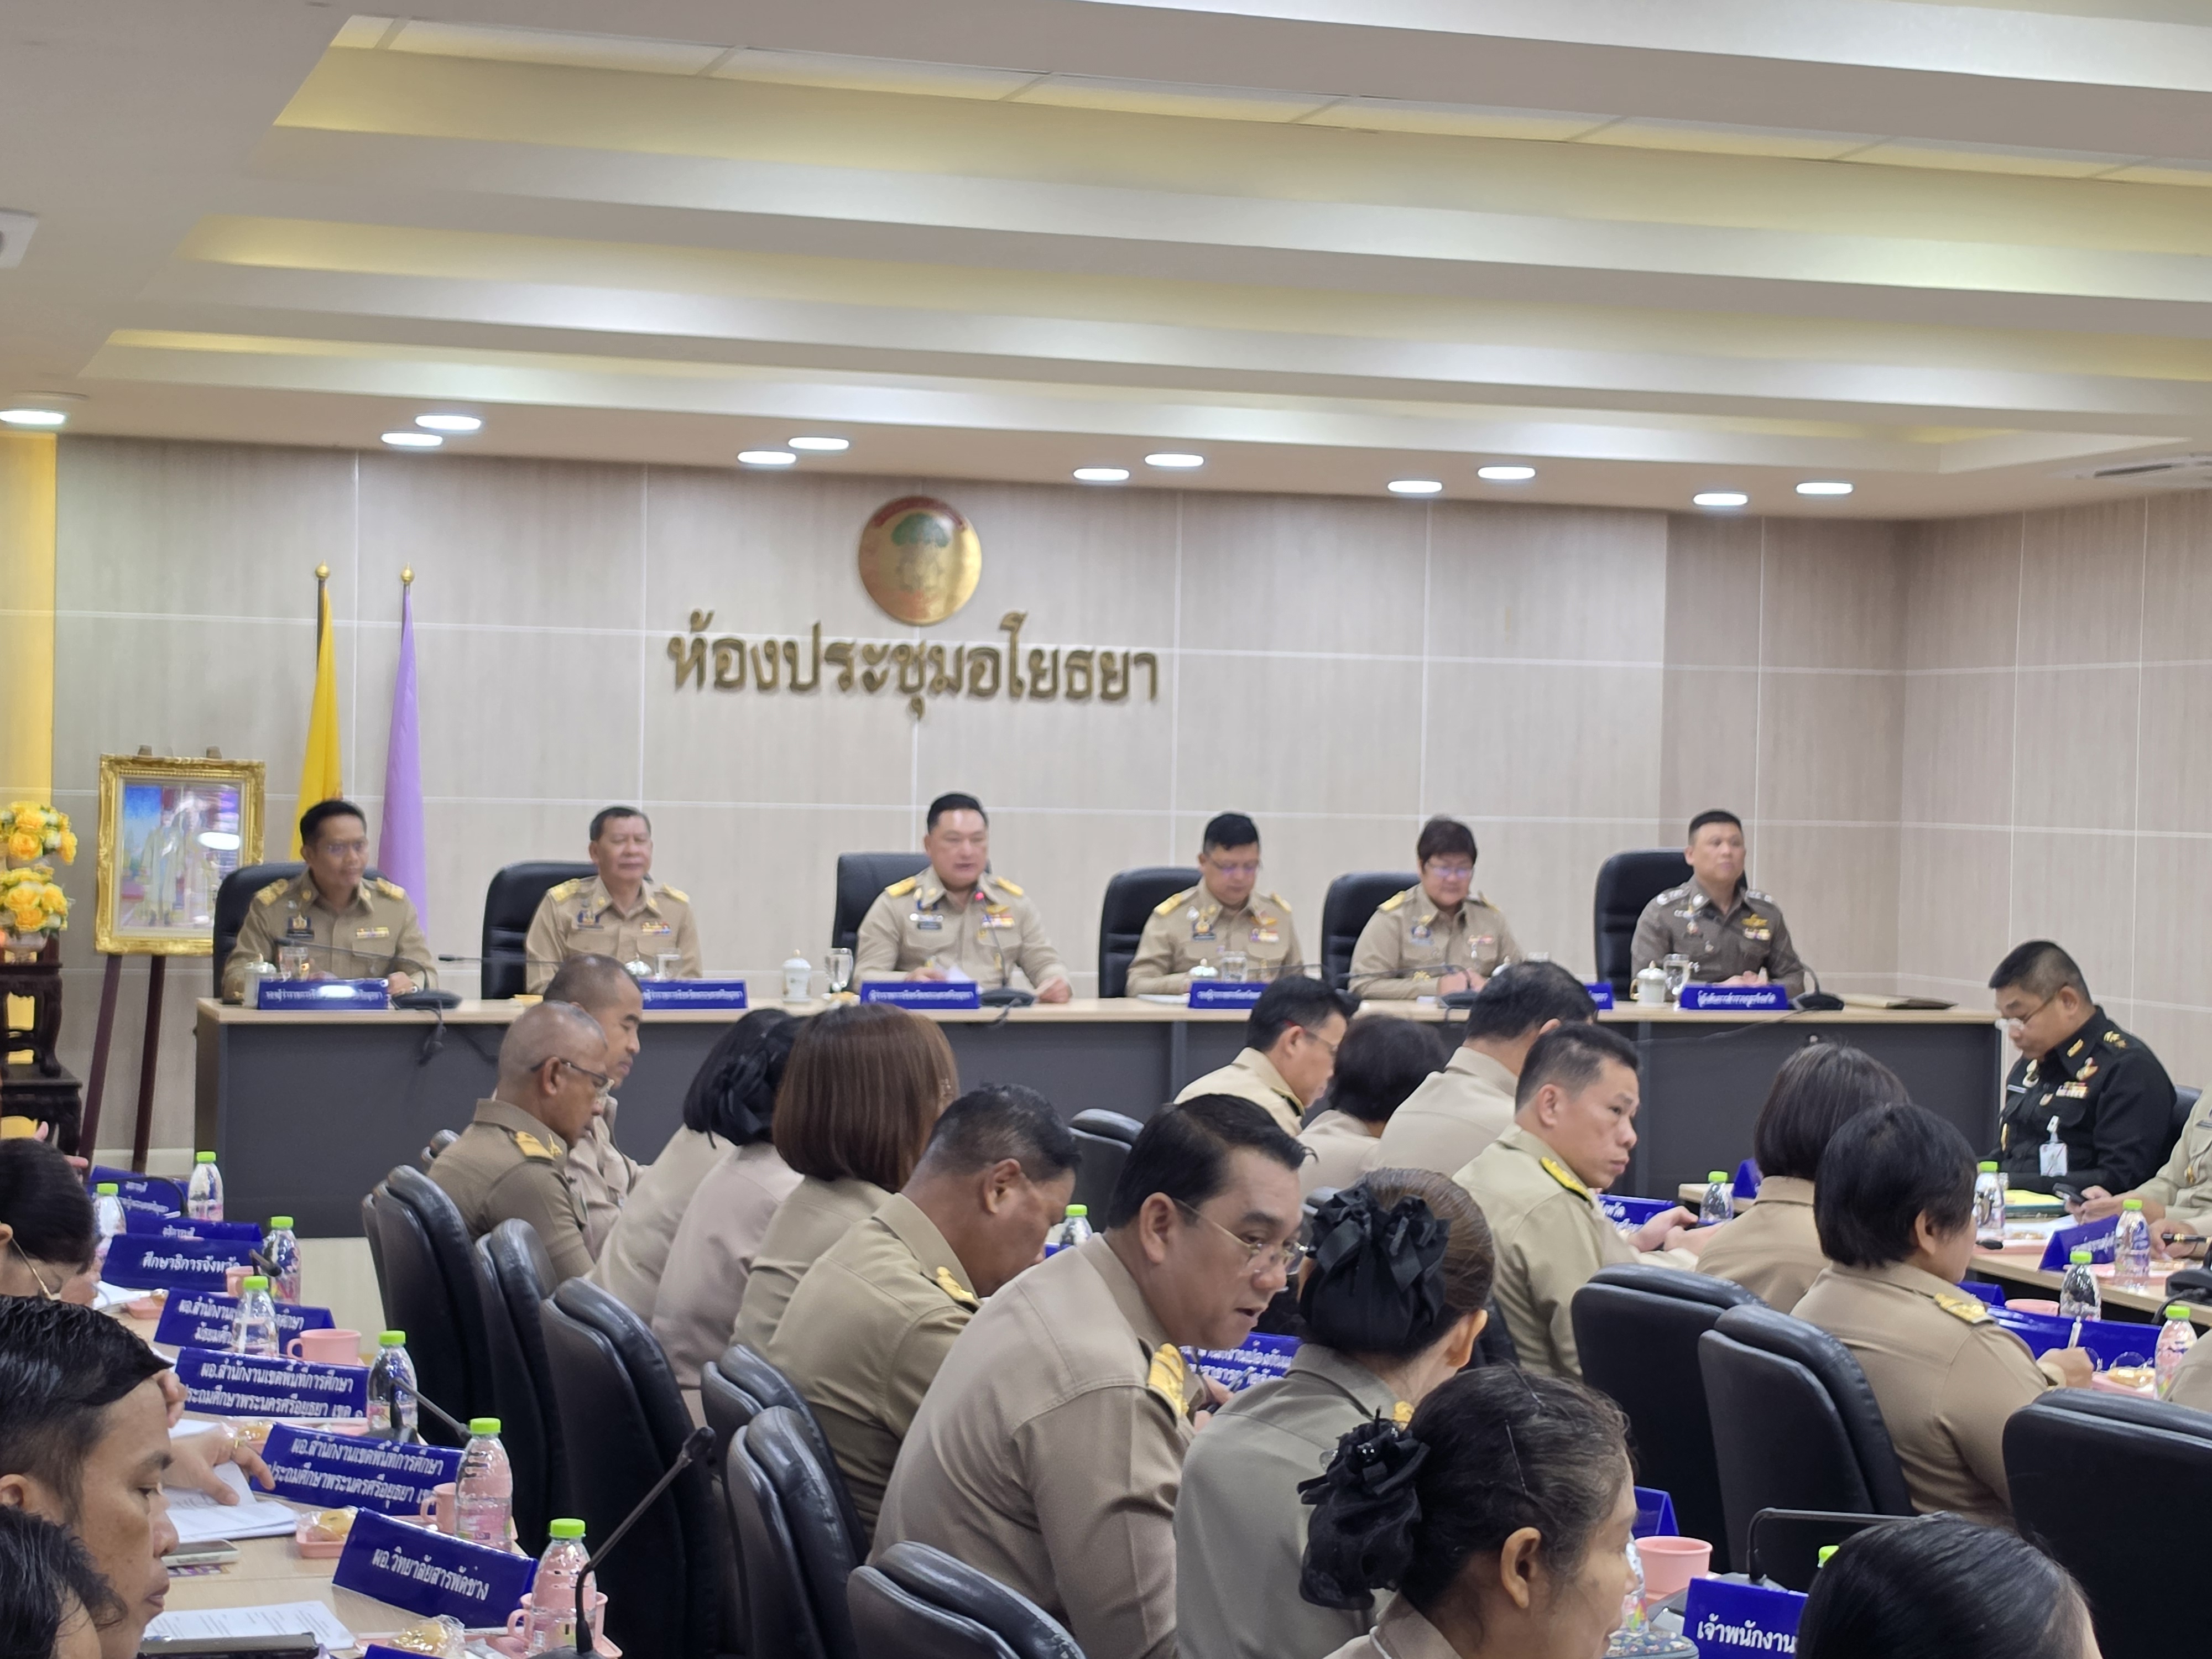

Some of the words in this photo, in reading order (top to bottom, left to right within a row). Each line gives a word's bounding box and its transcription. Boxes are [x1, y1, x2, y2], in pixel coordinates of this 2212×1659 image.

[667, 609, 1159, 719] ห้องประชุมอโยธยา
[186, 1384, 328, 1417] ระถมศึกษาพระนครศรีอยธยา
